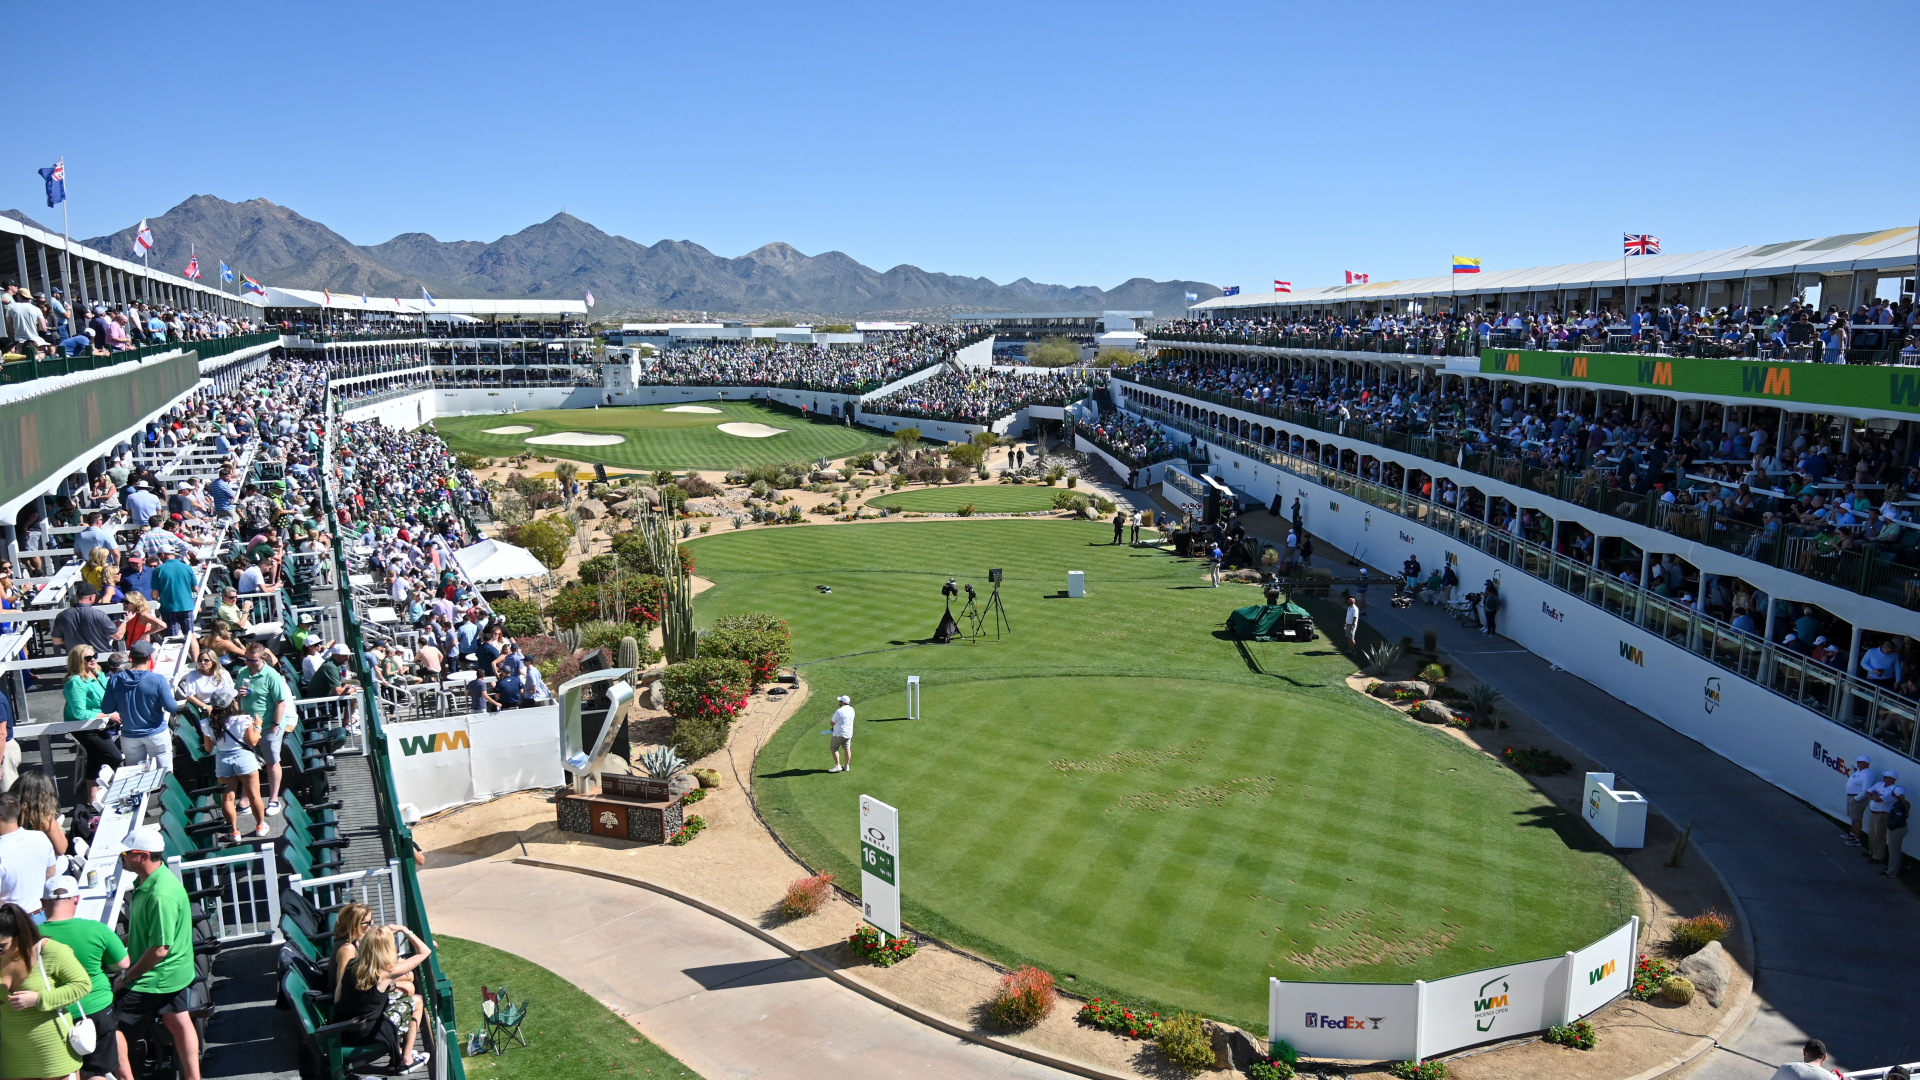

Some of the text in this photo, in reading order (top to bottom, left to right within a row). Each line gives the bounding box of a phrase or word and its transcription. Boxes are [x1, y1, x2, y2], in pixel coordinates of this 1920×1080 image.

[1495, 353, 1519, 372] WM
[1561, 356, 1587, 378] WM
[1638, 360, 1673, 386] WM
[1743, 366, 1791, 396] WM
[1891, 374, 1920, 407] W
[1619, 640, 1644, 668] WM
[1704, 686, 1720, 702] WM
[399, 730, 471, 756] WM
[1822, 748, 1851, 778] FedEx
[863, 834, 890, 851] OAKLEY
[862, 847, 877, 866] 16
[1589, 959, 1616, 986] WM
[1474, 994, 1509, 1012] WM
[1320, 1015, 1366, 1030] FedEx
[1475, 1010, 1495, 1019] PHOENIX
